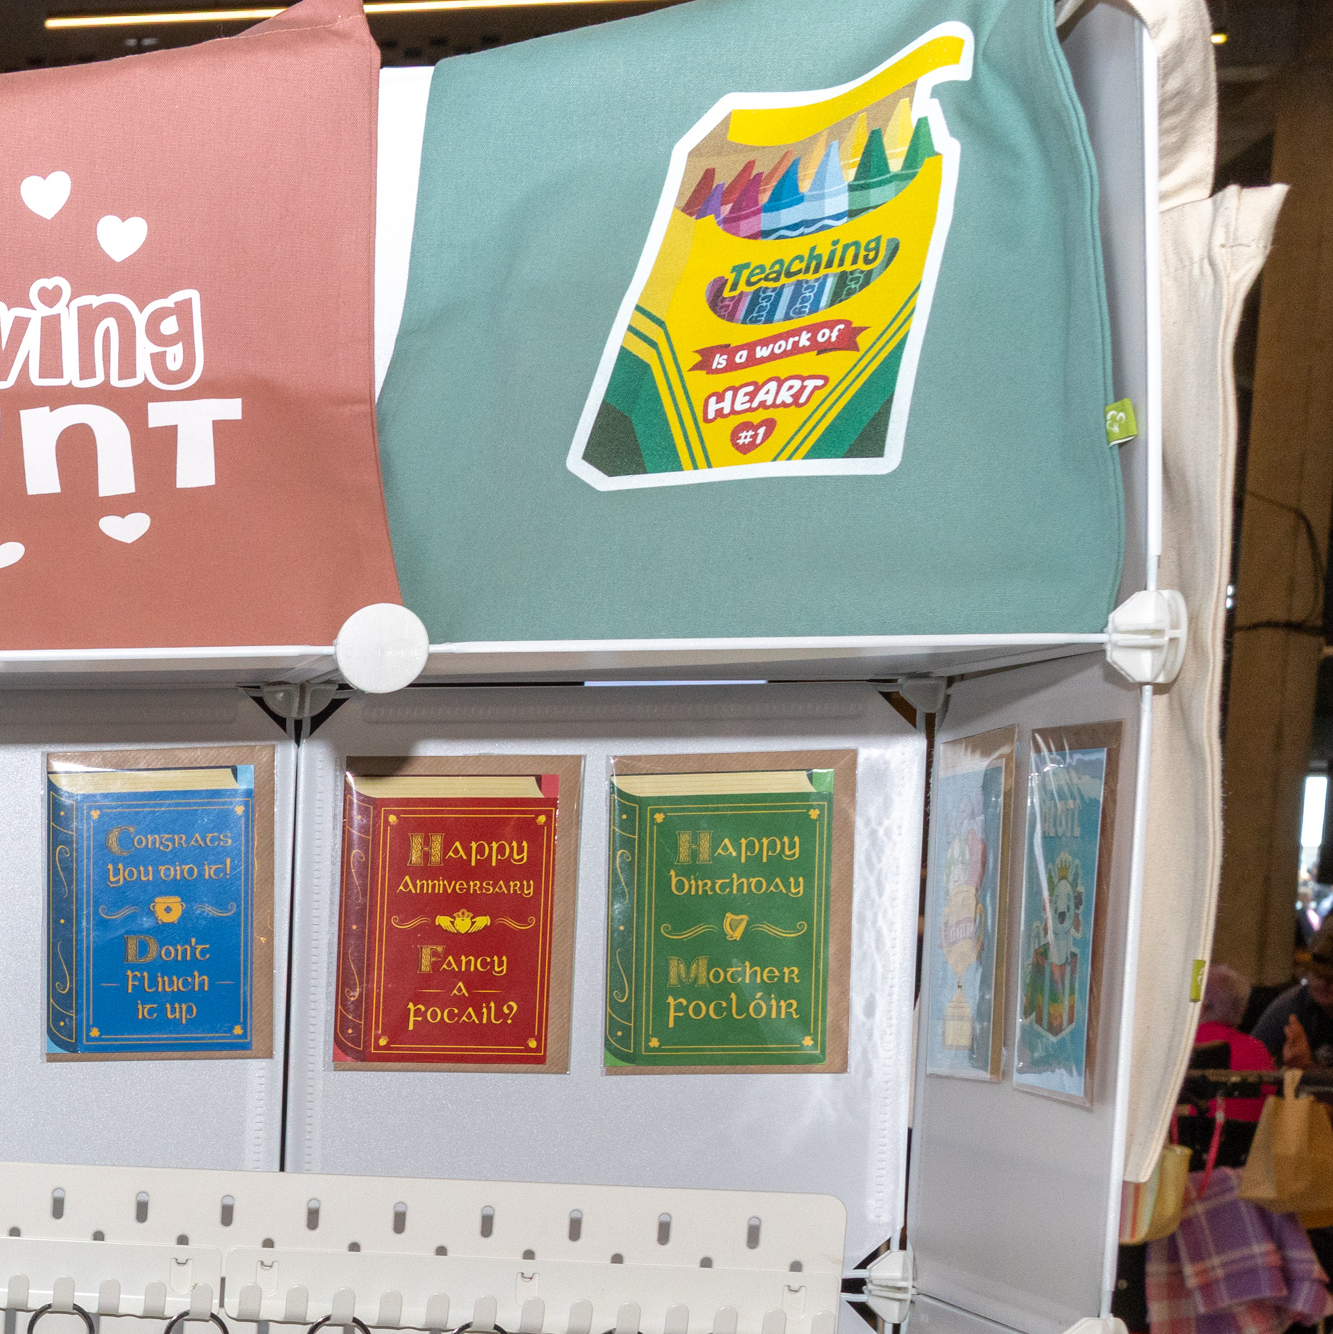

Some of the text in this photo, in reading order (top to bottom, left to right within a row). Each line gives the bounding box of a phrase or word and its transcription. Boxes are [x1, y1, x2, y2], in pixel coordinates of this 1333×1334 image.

[729, 235, 883, 293] Teaching
[734, 346, 748, 364] a
[754, 332, 812, 360] work
[817, 324, 845, 342] of
[706, 378, 825, 420] HEART
[736, 426, 766, 444] #1
